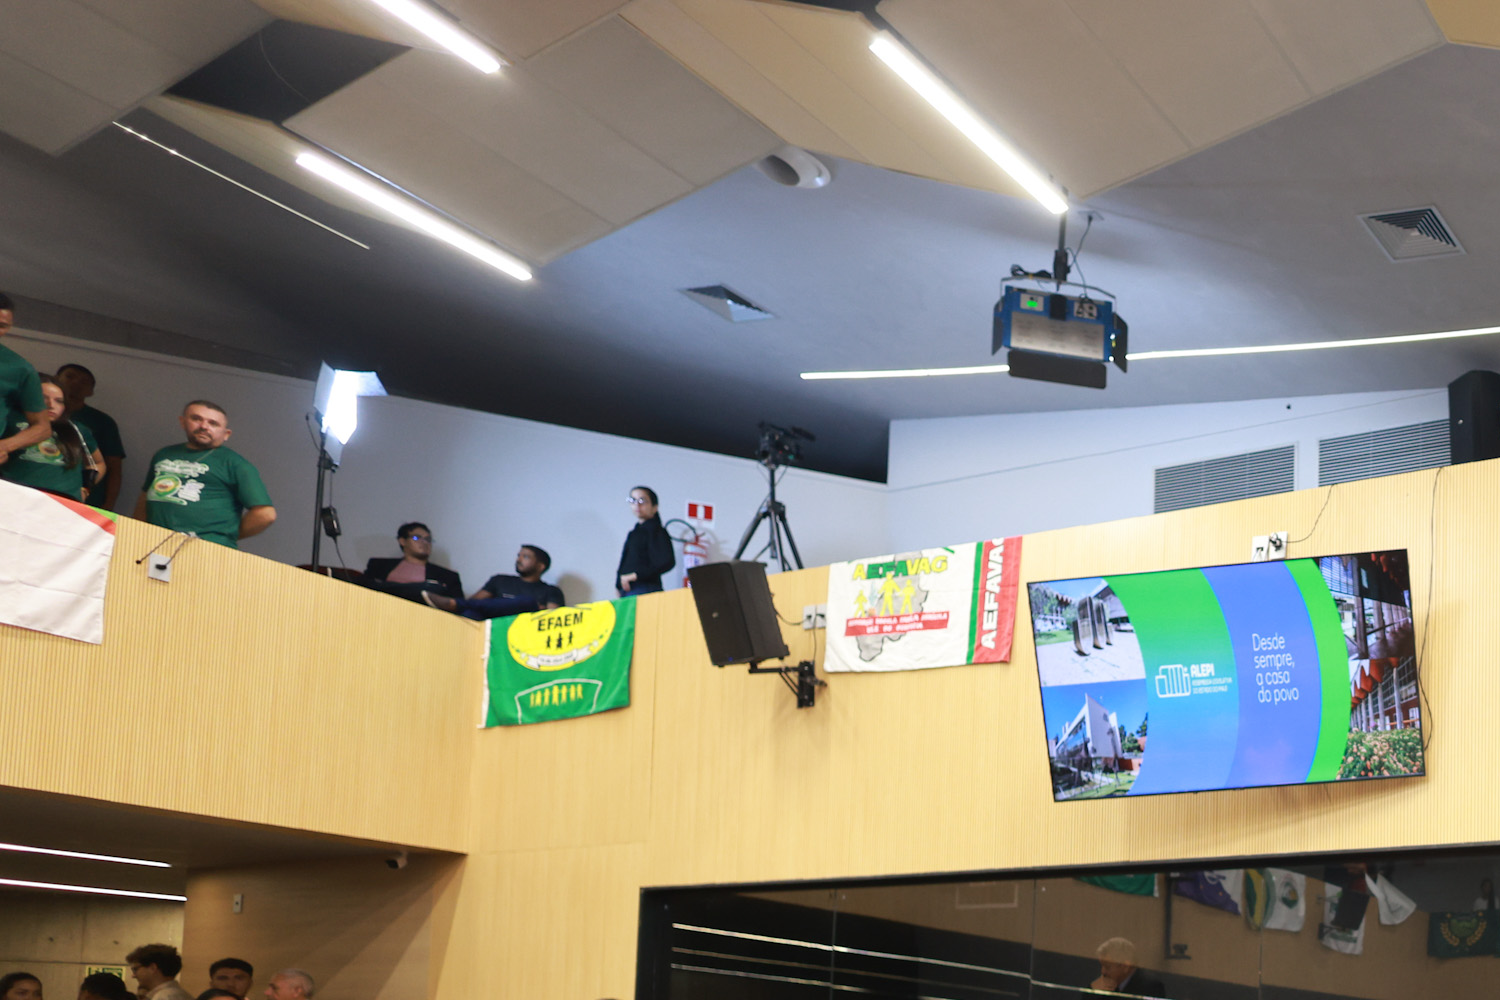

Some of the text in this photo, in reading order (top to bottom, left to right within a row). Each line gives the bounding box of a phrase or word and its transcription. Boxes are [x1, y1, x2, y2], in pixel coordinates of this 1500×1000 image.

[852, 556, 948, 580] AEFAVAG
[538, 612, 583, 631] EFAEM
[1252, 632, 1285, 651] Desde
[1190, 663, 1215, 677] ALEPI
[1254, 653, 1295, 670] sempre,
[1256, 671, 1290, 686] a casa
[1258, 686, 1299, 706] do povo
